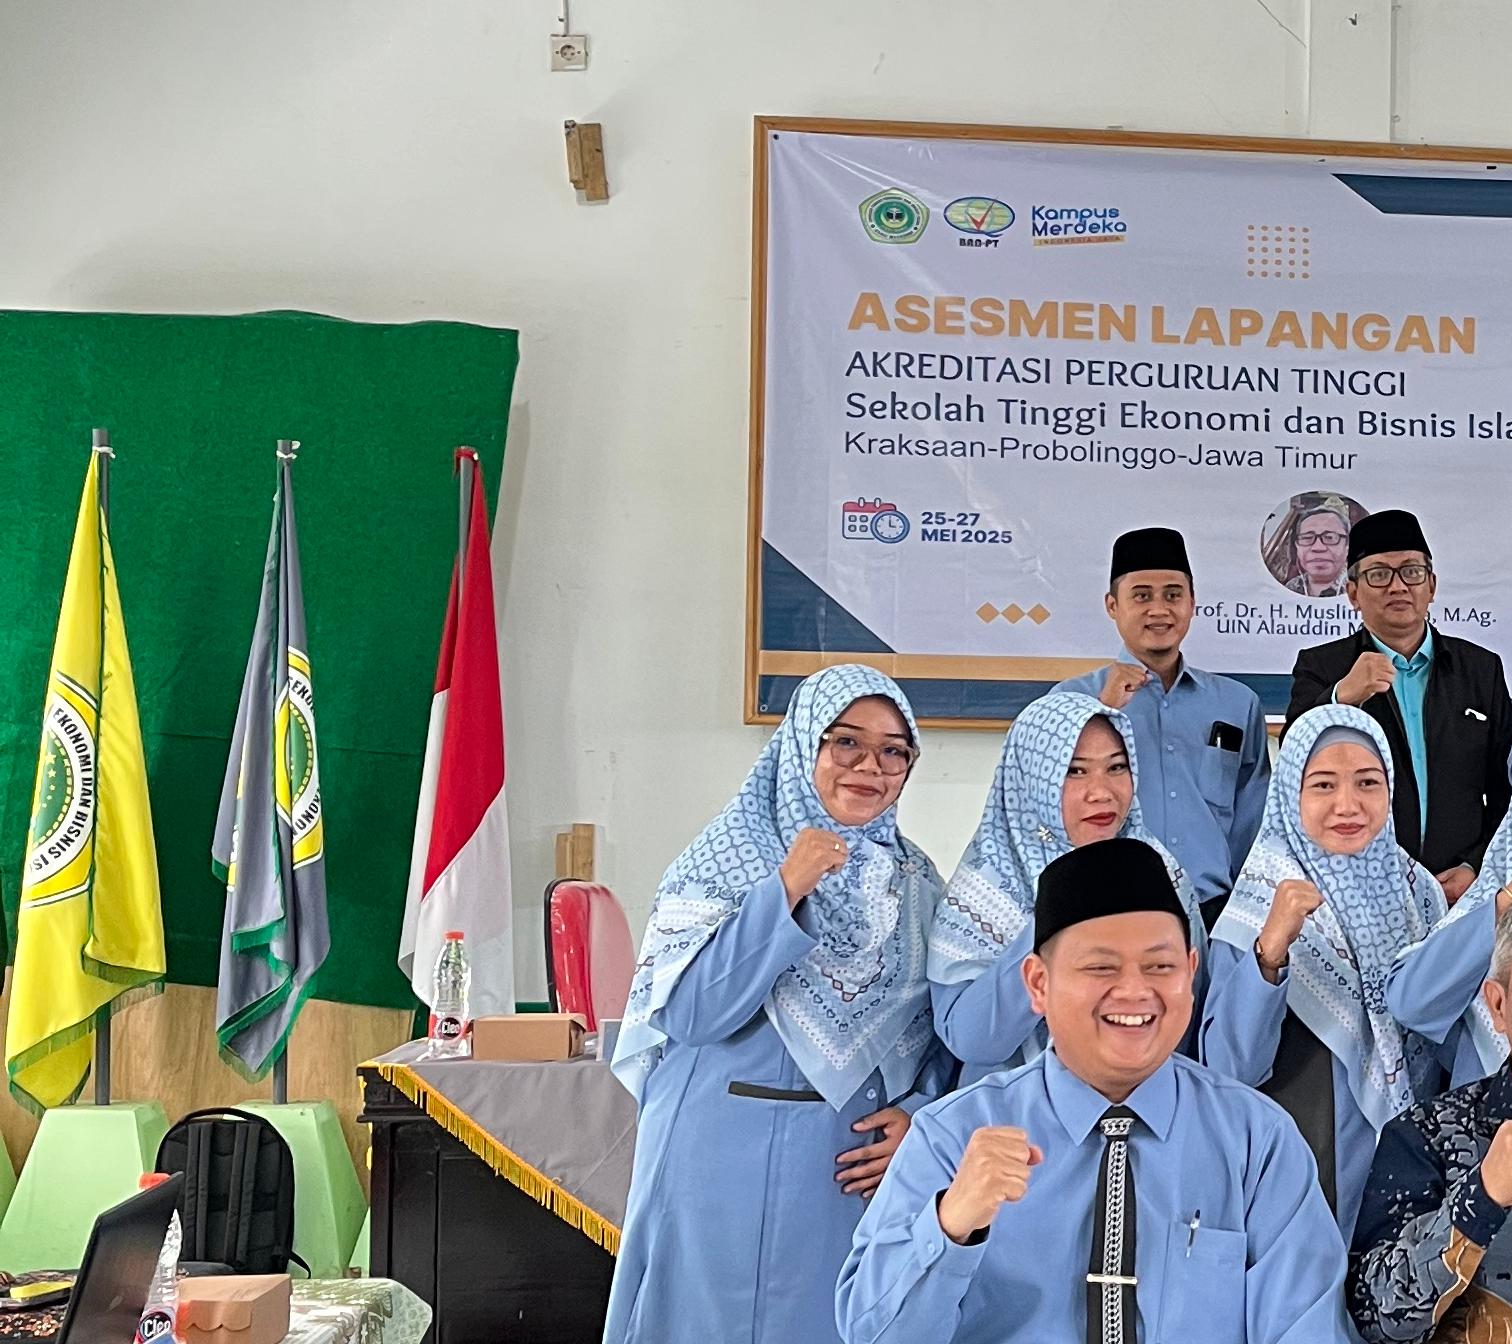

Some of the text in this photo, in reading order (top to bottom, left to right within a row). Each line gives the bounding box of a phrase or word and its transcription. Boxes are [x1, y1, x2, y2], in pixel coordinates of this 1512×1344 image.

[1032, 205, 1119, 226] Kampus
[1032, 216, 1127, 236] Merdeka
[848, 292, 1476, 355] ASESMEN LAPANGAN
[845, 351, 1406, 397] AKREDITASI PERGURUAN TINGGI
[845, 391, 985, 423] Sekolah
[997, 399, 1106, 436] Tinggi
[1120, 400, 1271, 433] Ekonomi
[1284, 406, 1345, 434] dan
[1358, 410, 1456, 438] Bisnis
[845, 431, 1358, 470] Kraksaan-Probolinggo-Jawa Timur
[921, 511, 981, 527] 25-27
[921, 528, 1013, 544] MEI 2025
[1195, 601, 1228, 618] rof.
[1236, 602, 1263, 619] Dr.
[1270, 604, 1289, 619] H.
[1444, 607, 1497, 628] M.Ag.
[1217, 619, 1251, 634] UIN
[1256, 619, 1341, 636] Alauddin
[53, 707, 93, 774] EKONOMI
[80, 776, 93, 808] DAN
[49, 811, 88, 860] BISNIS
[143, 1316, 172, 1338] Cleo
